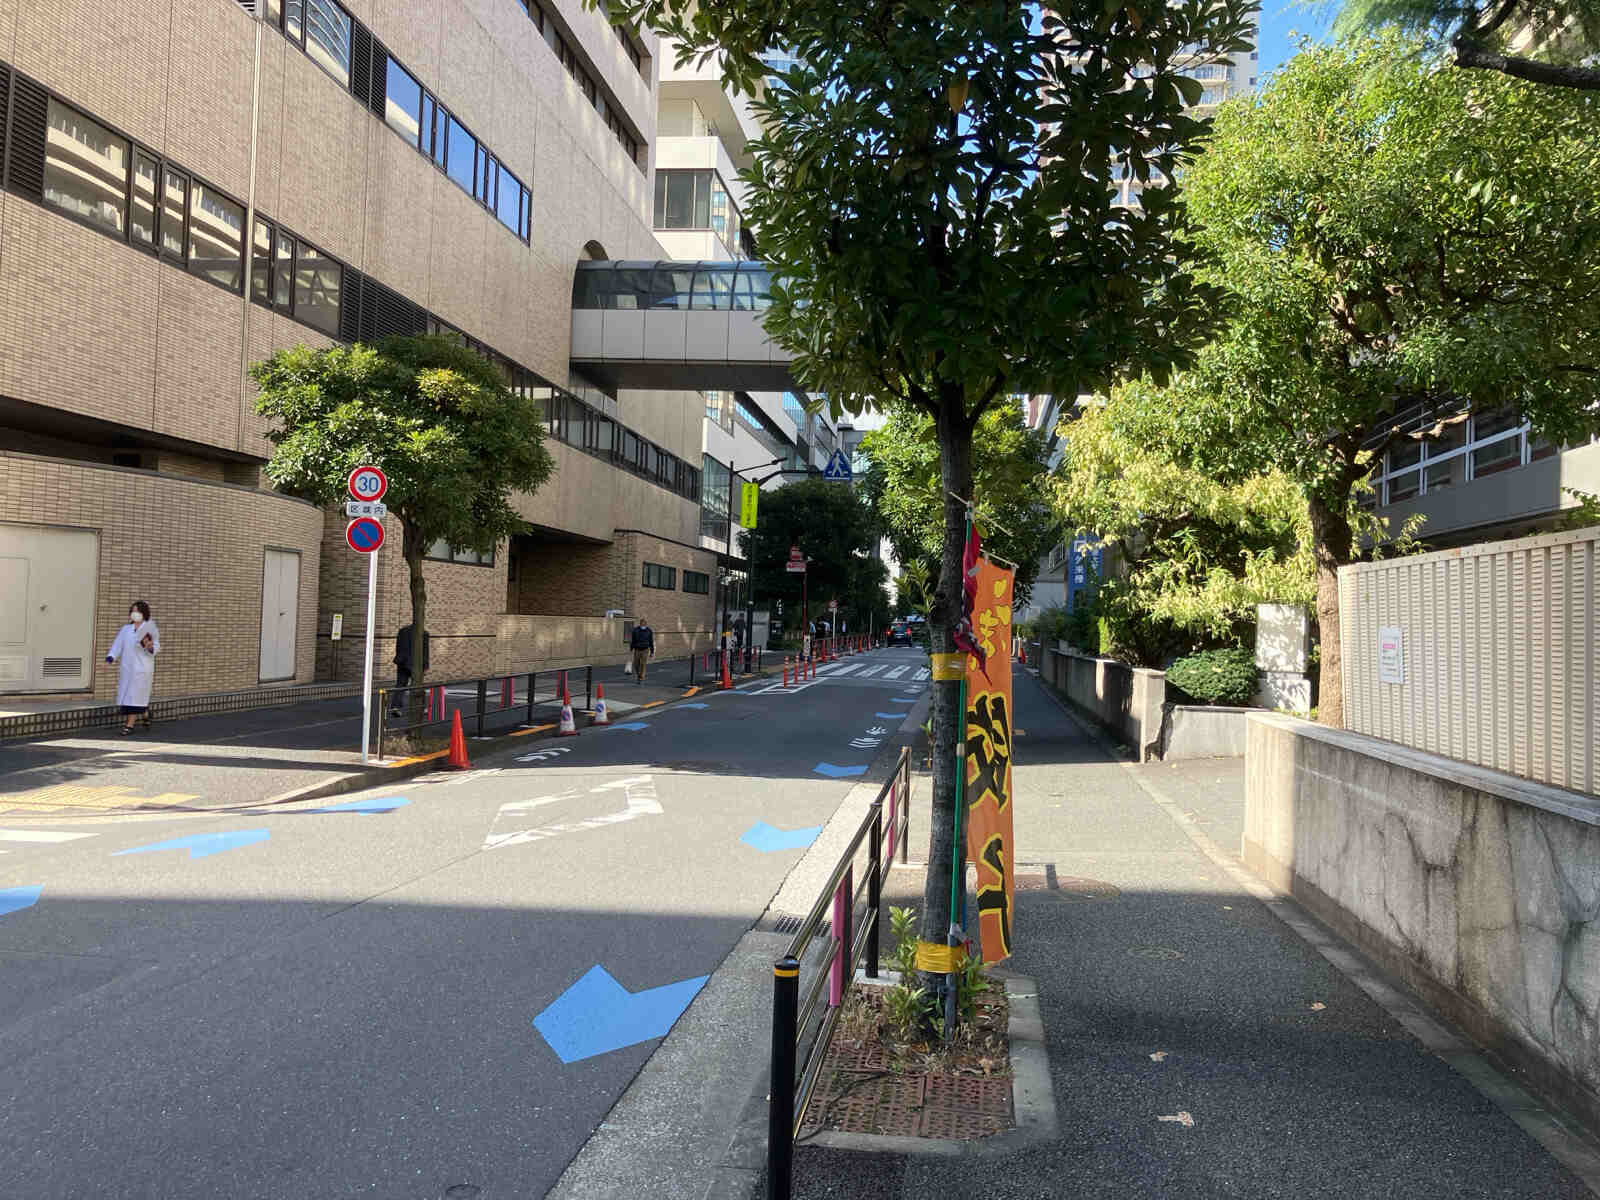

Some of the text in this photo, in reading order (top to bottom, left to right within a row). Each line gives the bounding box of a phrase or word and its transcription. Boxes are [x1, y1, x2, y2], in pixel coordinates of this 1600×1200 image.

[358, 476, 379, 492] 30
[350, 504, 384, 514] 区域内
